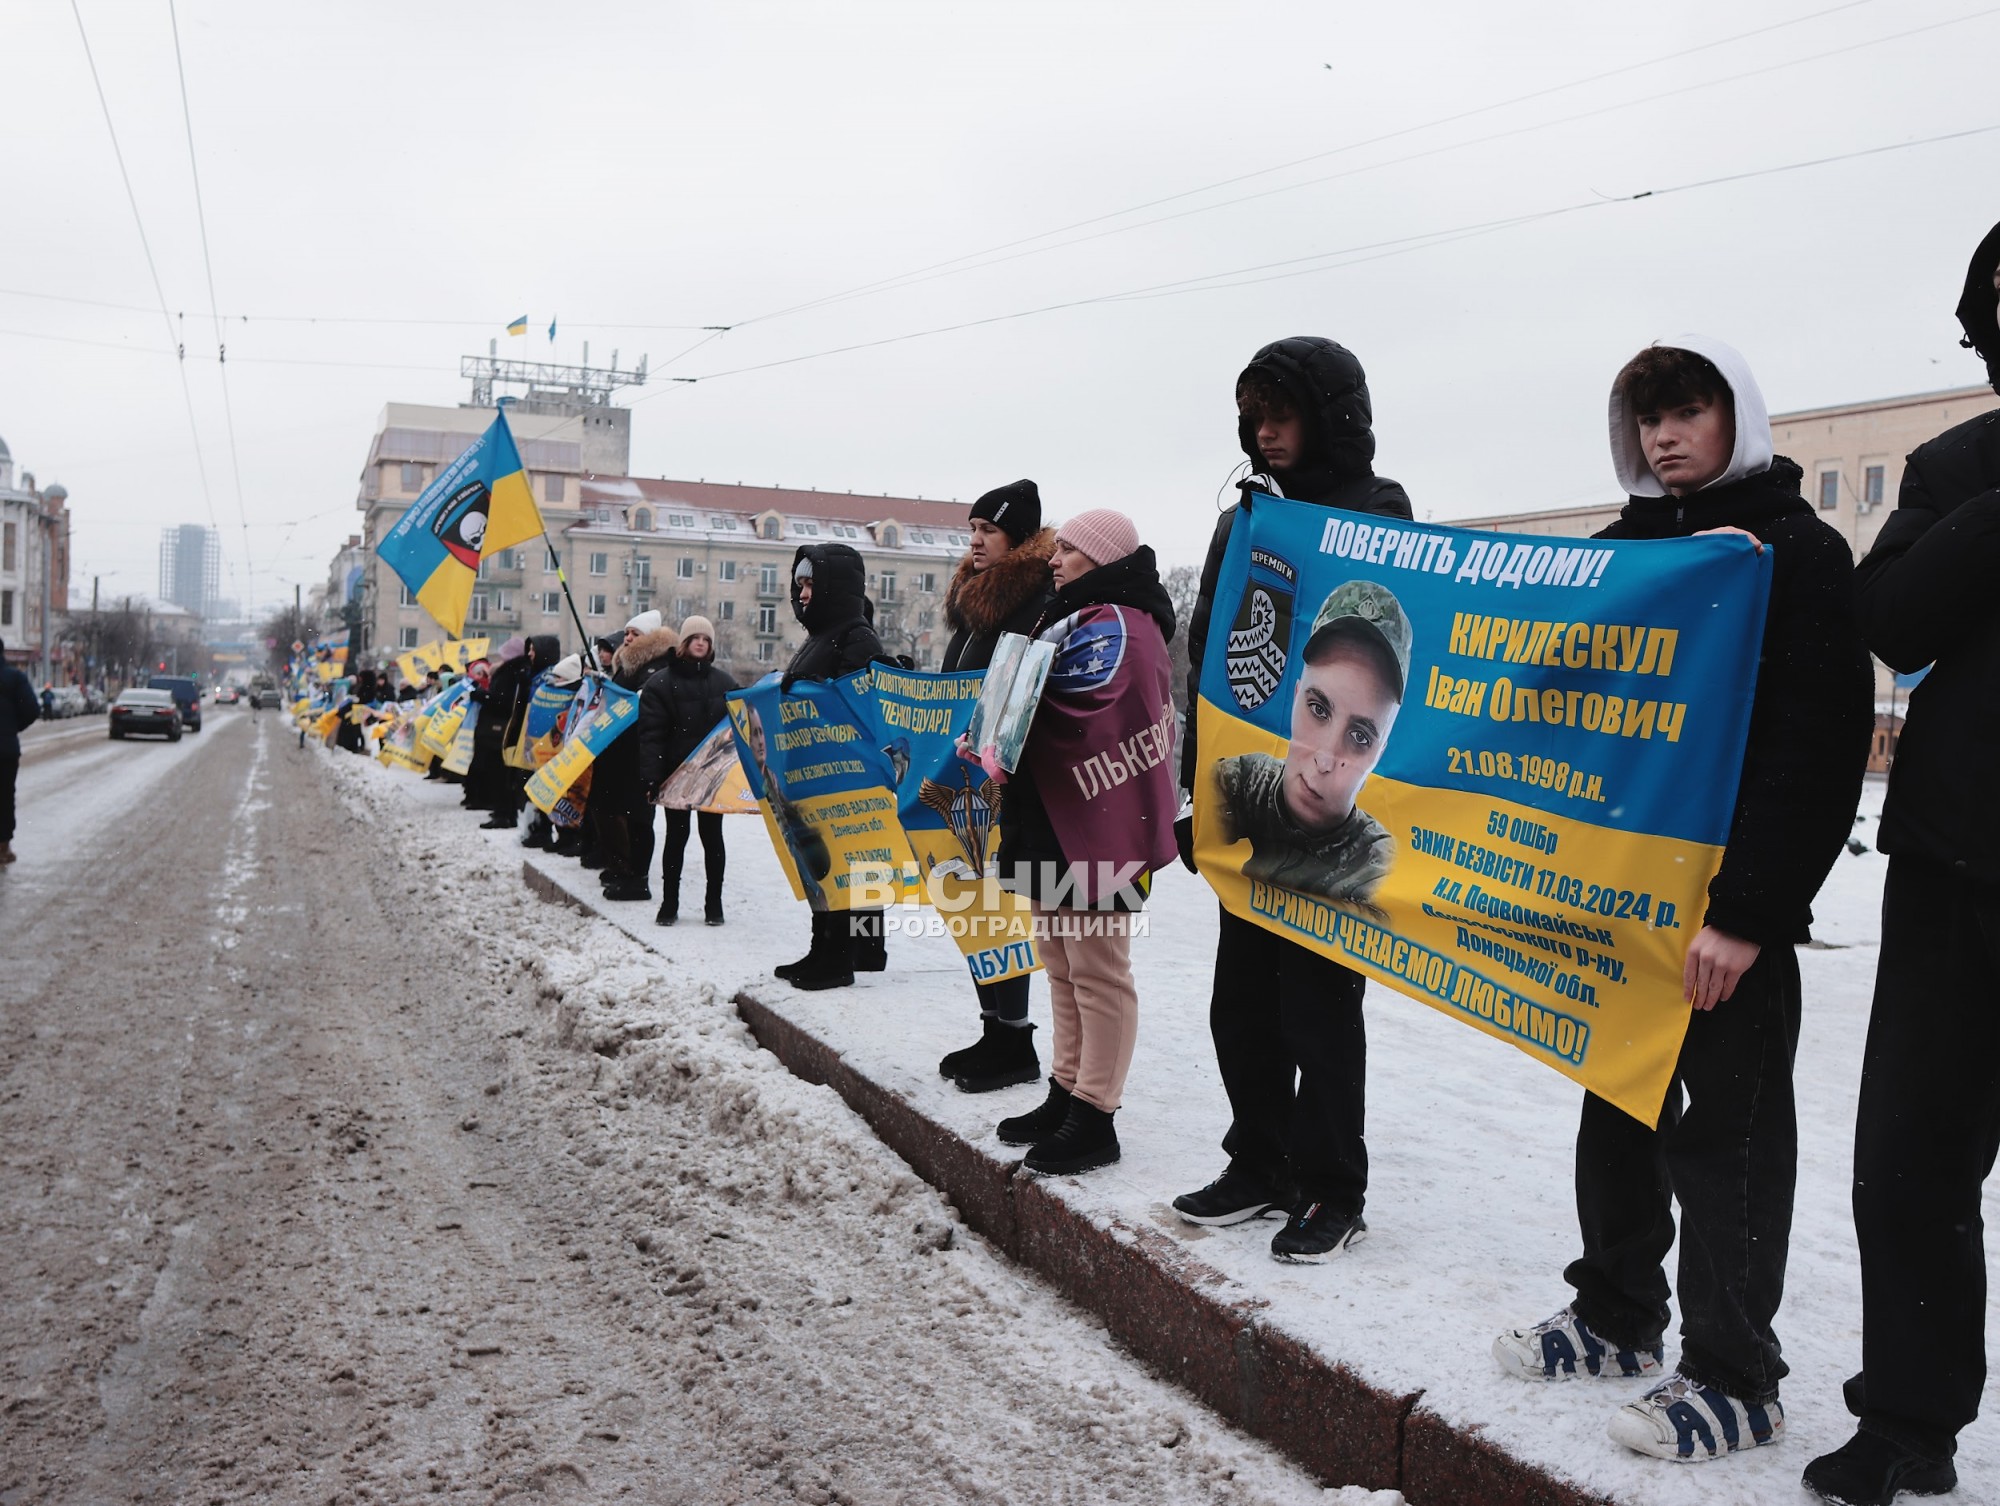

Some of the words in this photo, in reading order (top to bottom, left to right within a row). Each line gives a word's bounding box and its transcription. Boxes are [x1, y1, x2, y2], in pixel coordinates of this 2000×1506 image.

[1319, 517, 1456, 575] ПОВЕРНІТЬ
[1455, 540, 1614, 589] ДОДОМУ!
[1448, 612, 1679, 677] КИРИЛЕСКУЛ
[876, 671, 958, 701] ПОВІТРЯНОДЕСАНТНА
[1425, 666, 1487, 717] Іван
[1490, 677, 1687, 743] Олегович
[912, 706, 952, 735] ЕДУАРД
[784, 769, 804, 784] ЗНИК
[1447, 748, 1569, 792] 21.08.1998
[1568, 771, 1605, 802] р.н.
[830, 822, 869, 838] Донецька
[1487, 811, 1508, 838] 59
[1510, 817, 1558, 855] ОШБр
[1411, 826, 1455, 862] ЗНИК
[1454, 841, 1535, 891] БЕЗВІСТИ
[1538, 869, 1651, 921] 17.03.2024
[1655, 901, 1680, 928] р.
[1432, 877, 1460, 905] н.п.
[1464, 884, 1615, 947] Первомайськ
[1252, 880, 1336, 942] ВІРИМО!
[1339, 915, 1454, 997] ЧЕКАЄМО!
[1451, 969, 1588, 1063] ЛЮБИМО!
[1457, 925, 1557, 988] Донецької
[1554, 972, 1600, 1009] обл.
[1576, 949, 1628, 985] р-ну,
